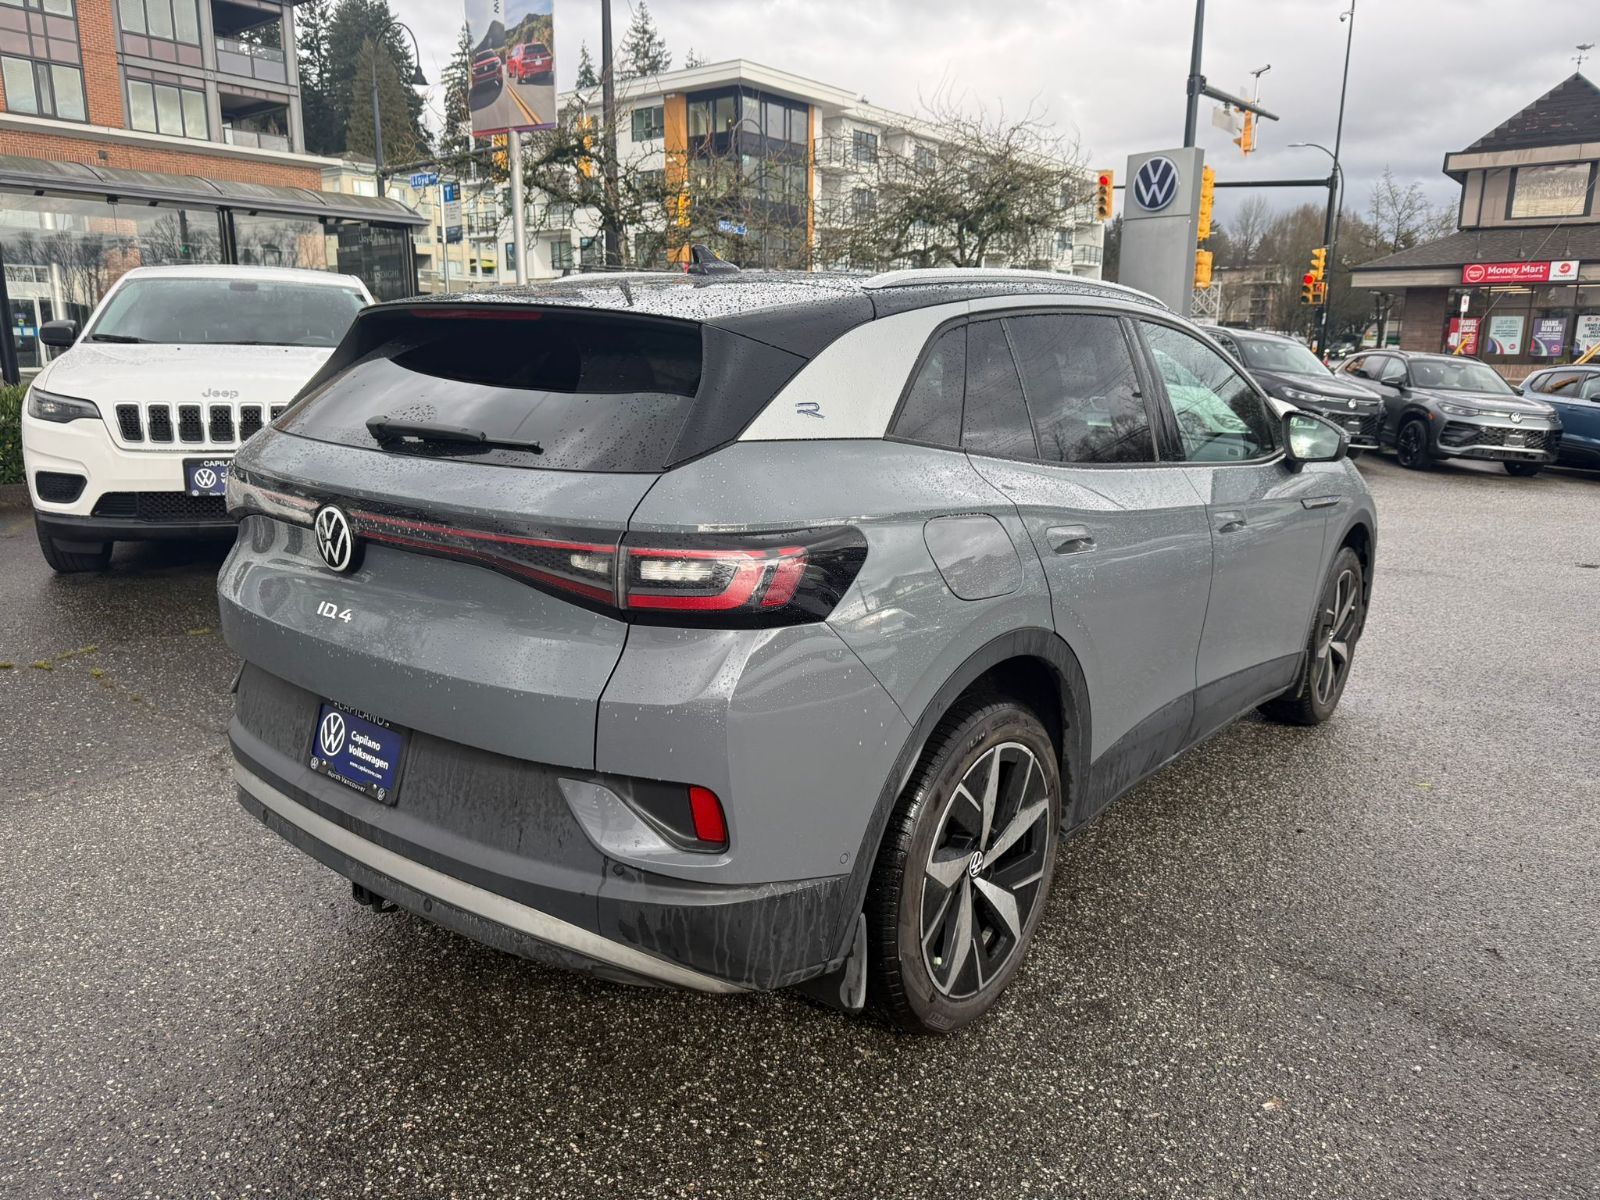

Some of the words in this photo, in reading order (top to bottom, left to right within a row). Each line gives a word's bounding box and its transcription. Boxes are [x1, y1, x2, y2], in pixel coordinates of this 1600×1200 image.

[1487, 266, 1519, 275] Money
[1521, 265, 1545, 273] Mart
[202, 388, 239, 399] Jeep
[351, 730, 381, 751] Capilano
[348, 743, 389, 770] Volkswagen
[328, 770, 341, 781] North
[341, 776, 366, 792] Vancouver
